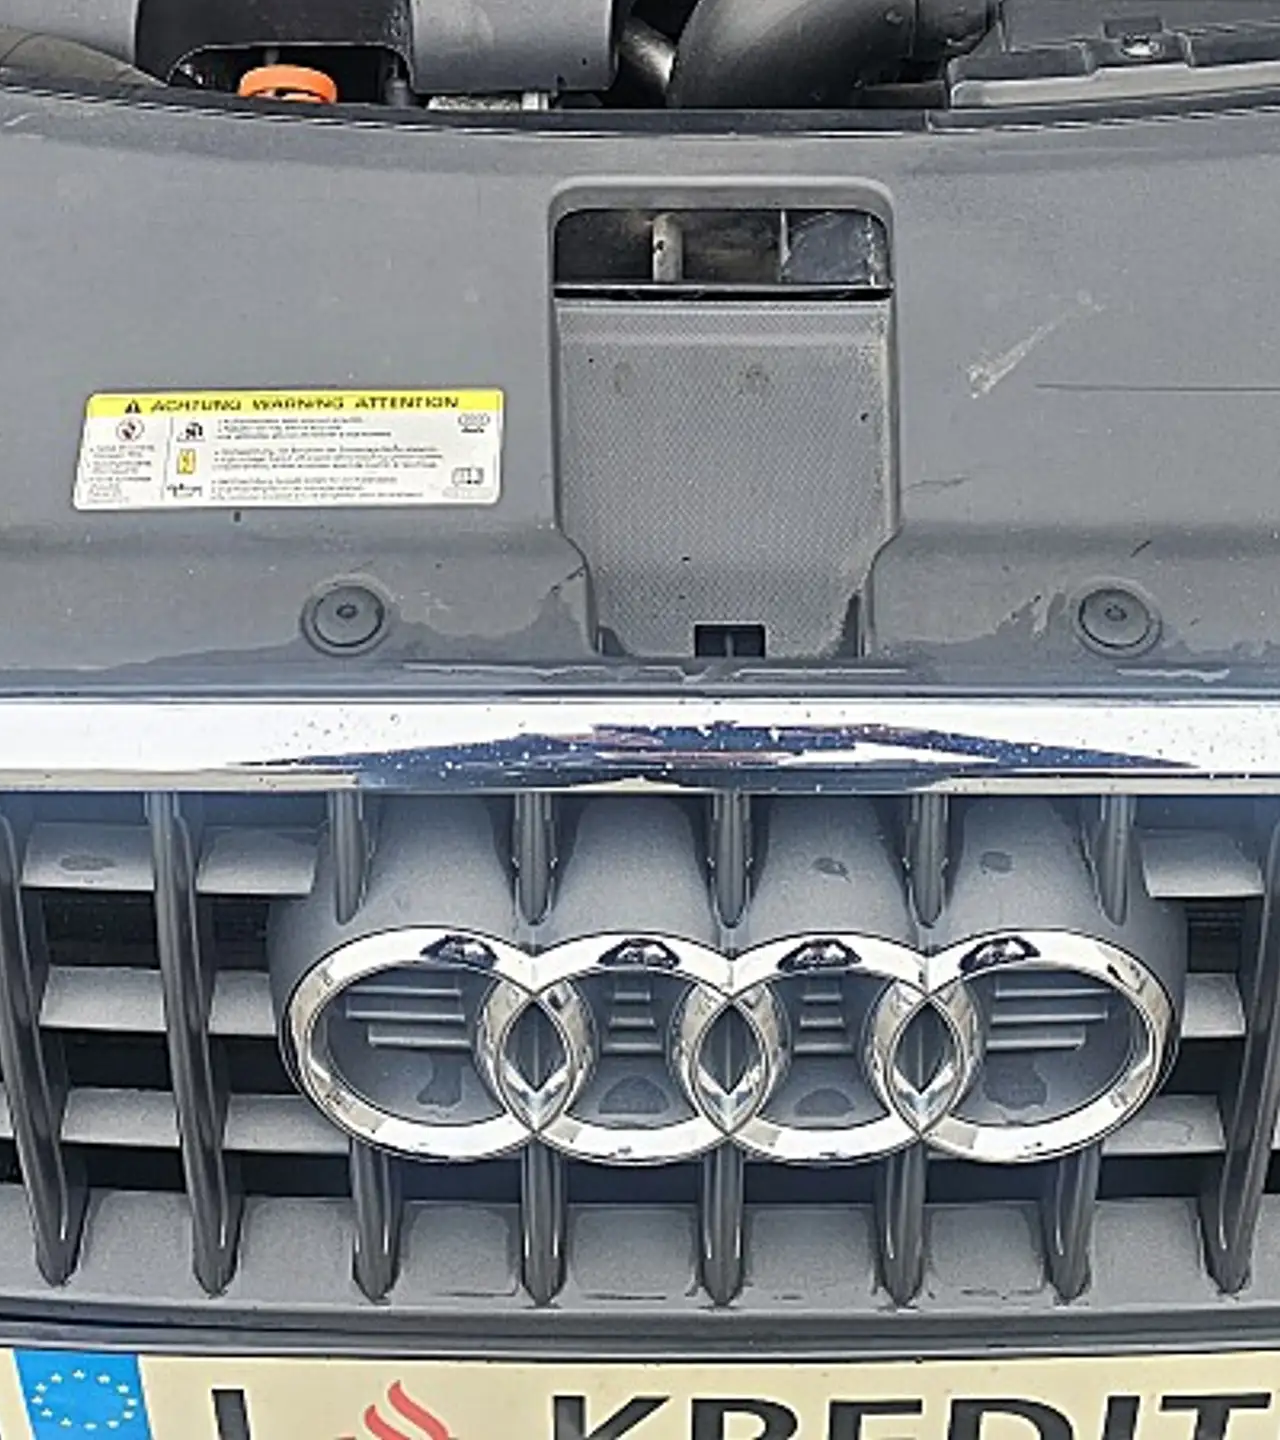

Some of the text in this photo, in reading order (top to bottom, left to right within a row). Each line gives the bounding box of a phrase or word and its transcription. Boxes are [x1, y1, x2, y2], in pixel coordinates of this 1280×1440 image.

[150, 396, 460, 412] ACHTUNG WARNING ATTENTION
